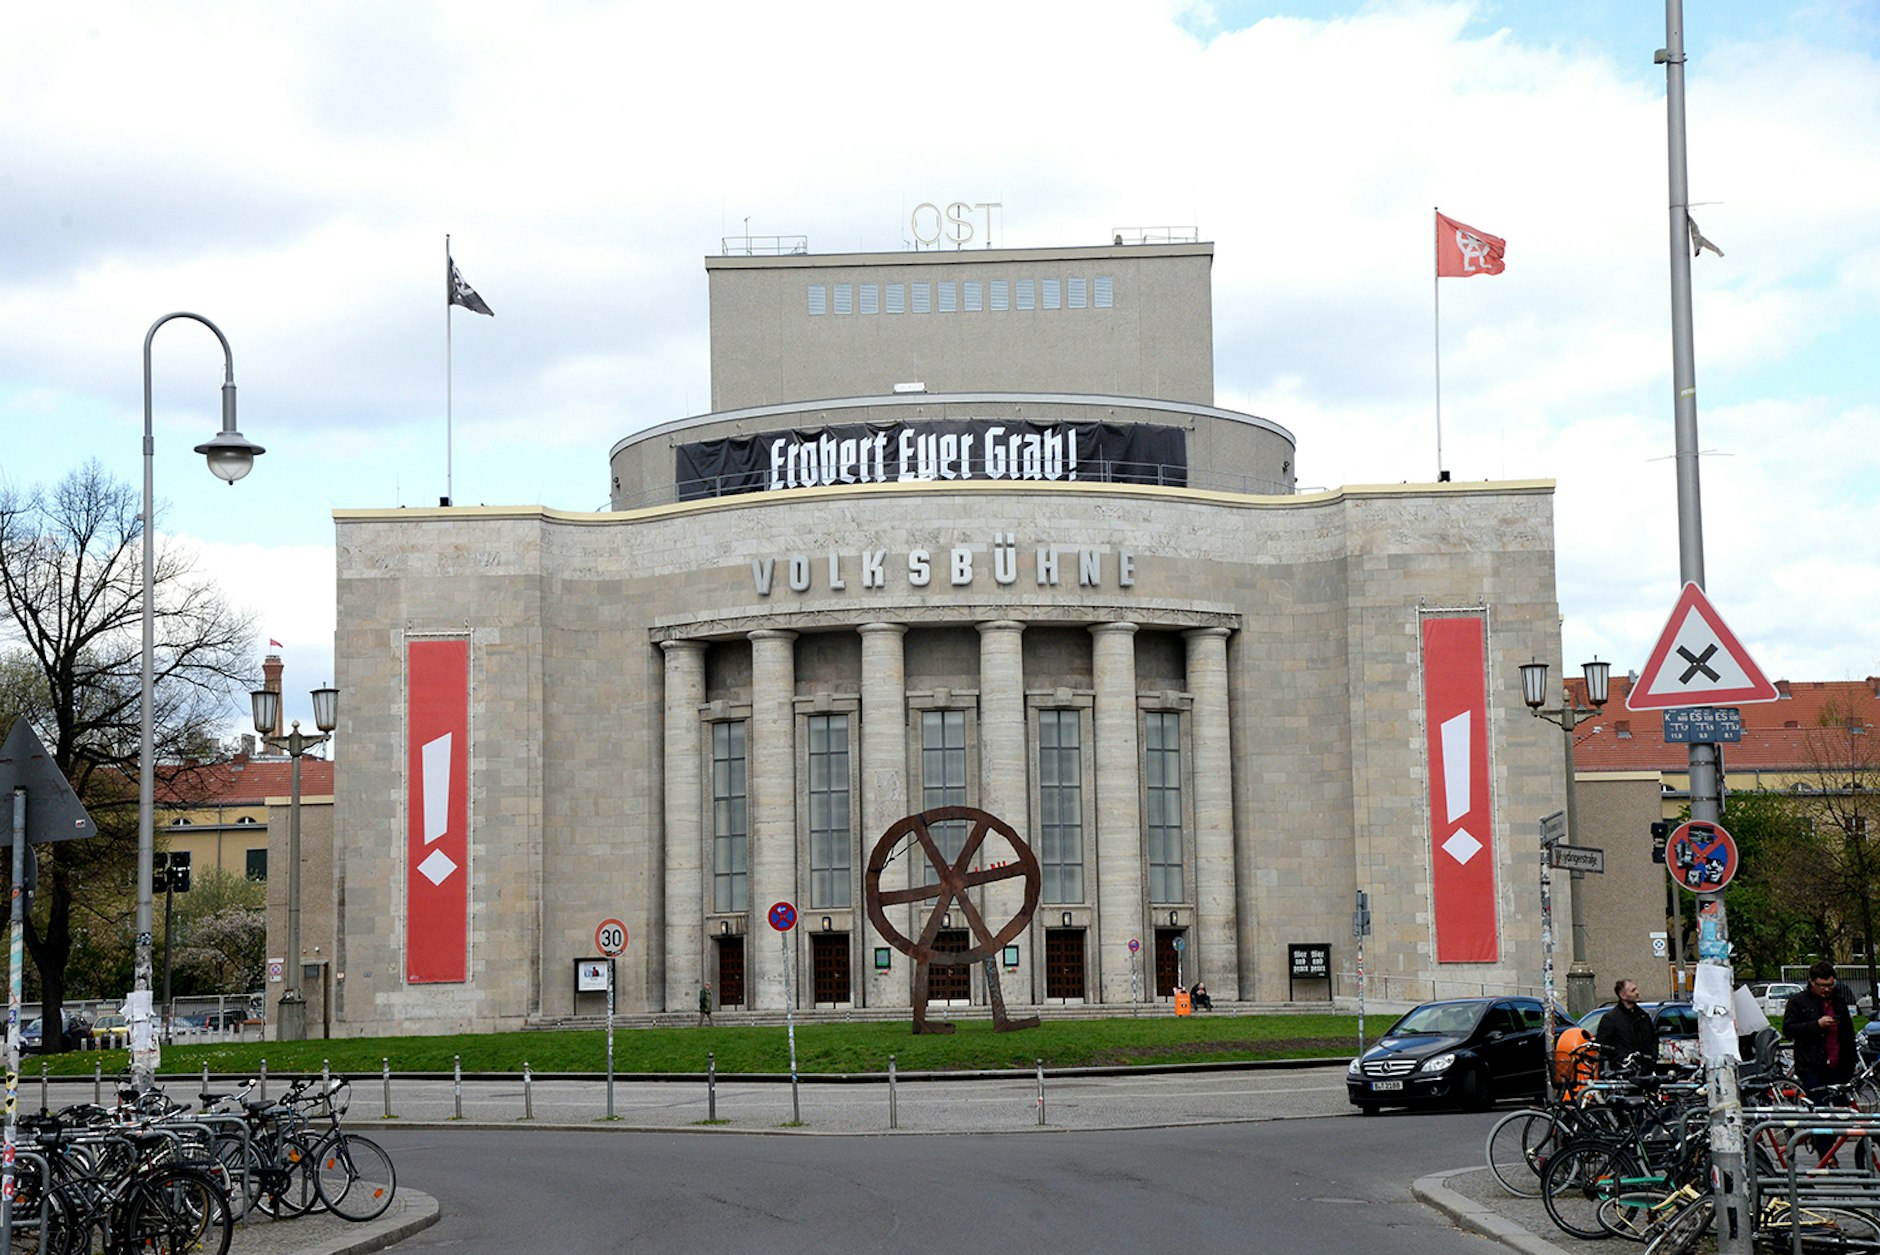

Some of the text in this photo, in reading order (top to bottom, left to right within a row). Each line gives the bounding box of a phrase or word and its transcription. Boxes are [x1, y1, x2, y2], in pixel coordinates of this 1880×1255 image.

[911, 202, 1002, 244] OST
[769, 432, 888, 491] Erobert
[984, 426, 1077, 481] Grab!
[751, 531, 1136, 597] VOLKSBÜHNE
[1689, 712, 1702, 722] ES
[1715, 712, 1728, 722] ES
[602, 929, 622, 947] 30
